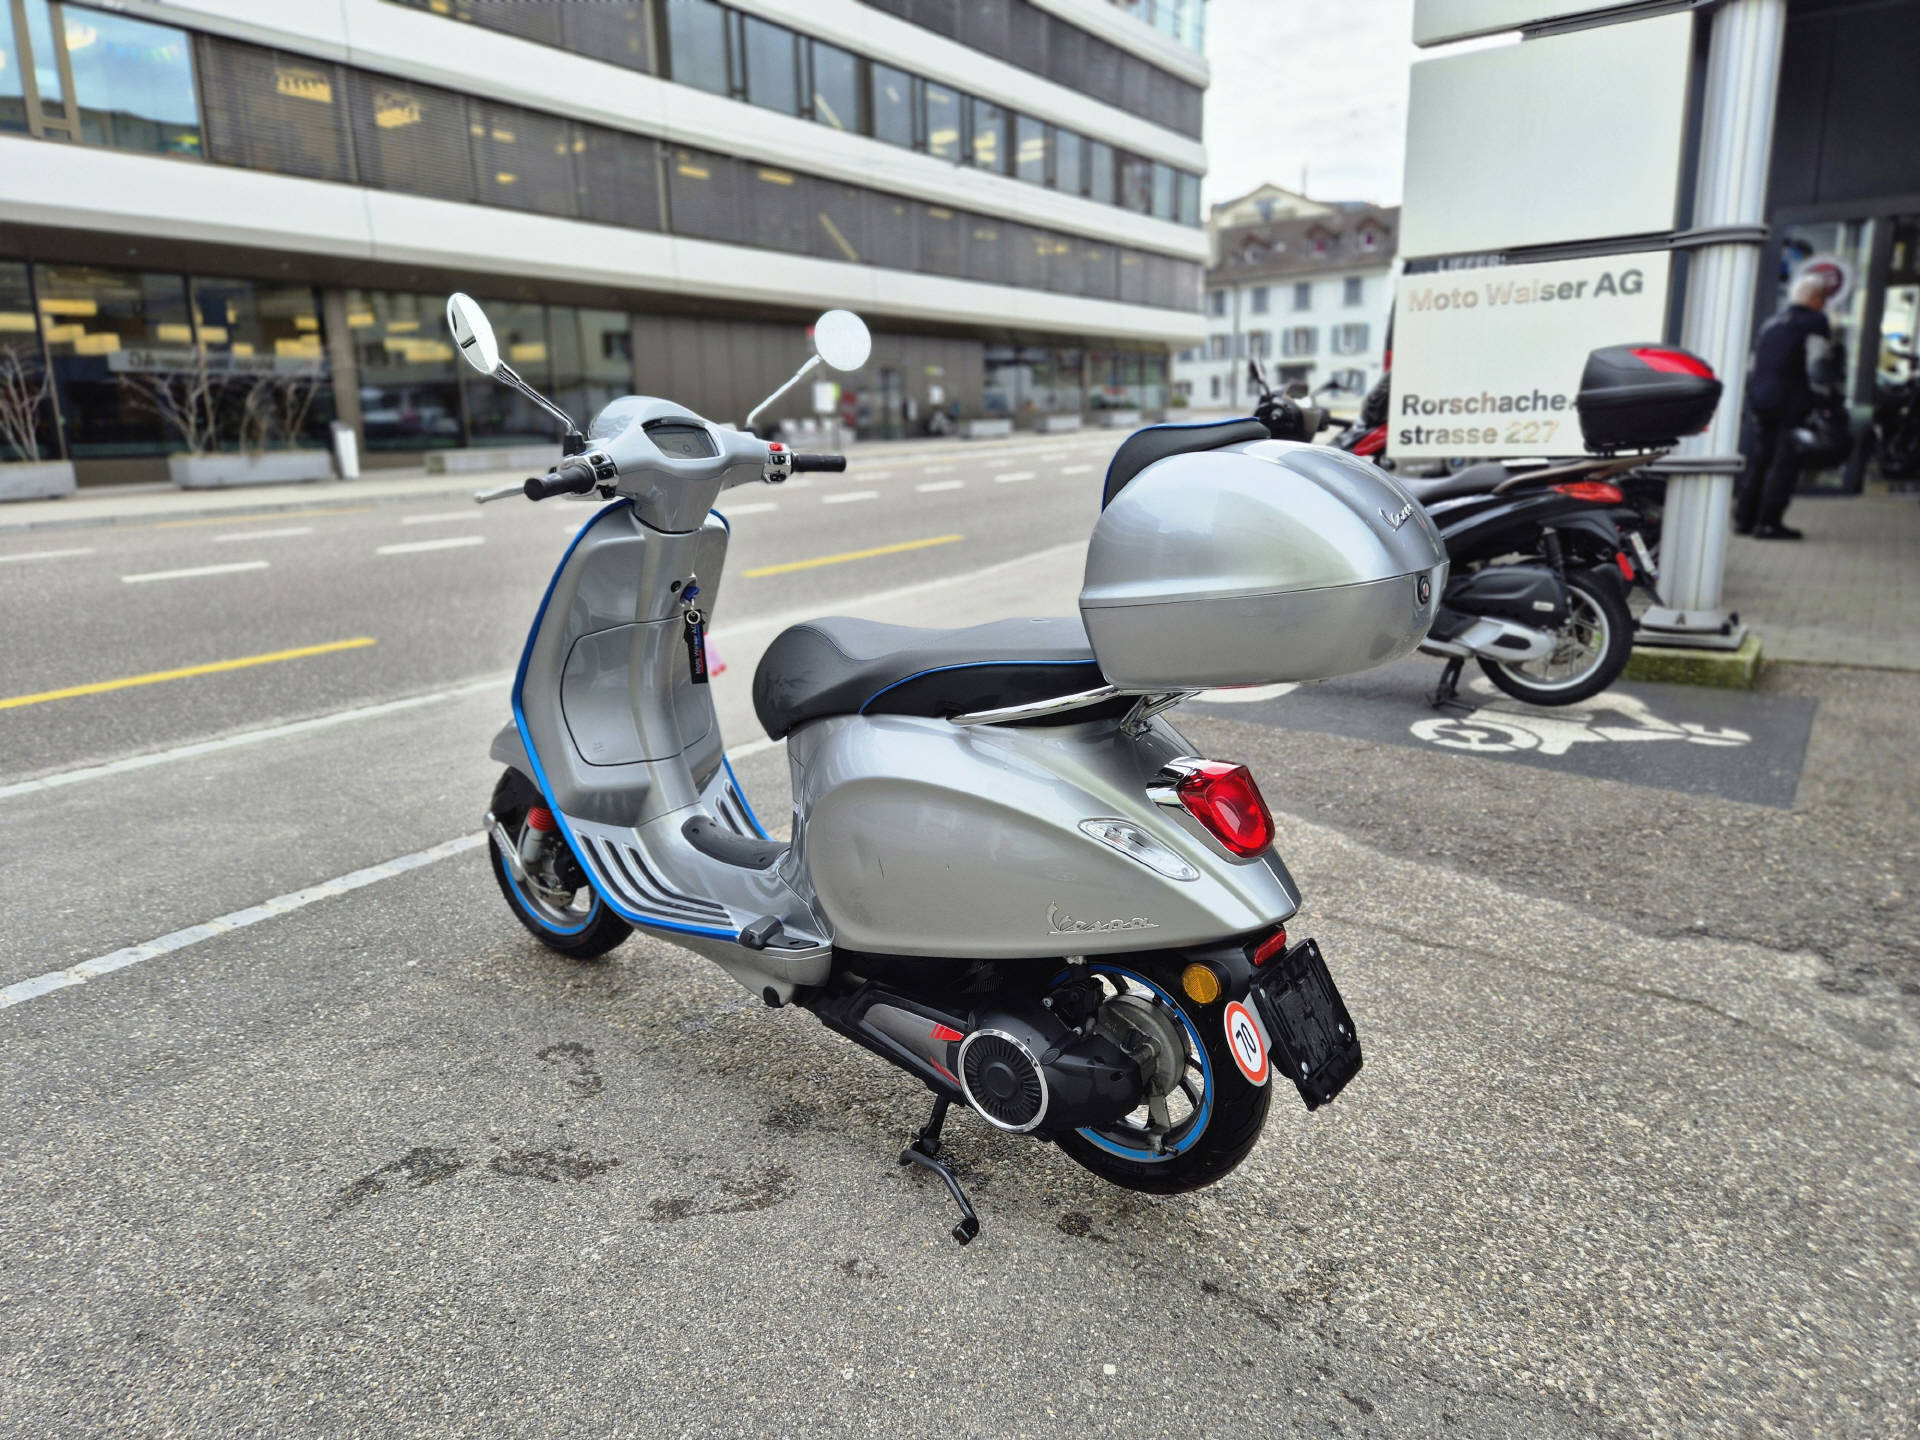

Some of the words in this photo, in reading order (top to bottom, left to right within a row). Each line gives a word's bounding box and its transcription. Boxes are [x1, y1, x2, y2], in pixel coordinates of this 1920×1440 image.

[1408, 288, 1479, 311] Moto
[1485, 279, 1588, 307] Walser
[1593, 269, 1643, 296] AG
[1400, 425, 1498, 445] strasse
[1505, 420, 1558, 444] 227
[1046, 899, 1160, 935] Vespa
[1235, 1022, 1257, 1062] 70
